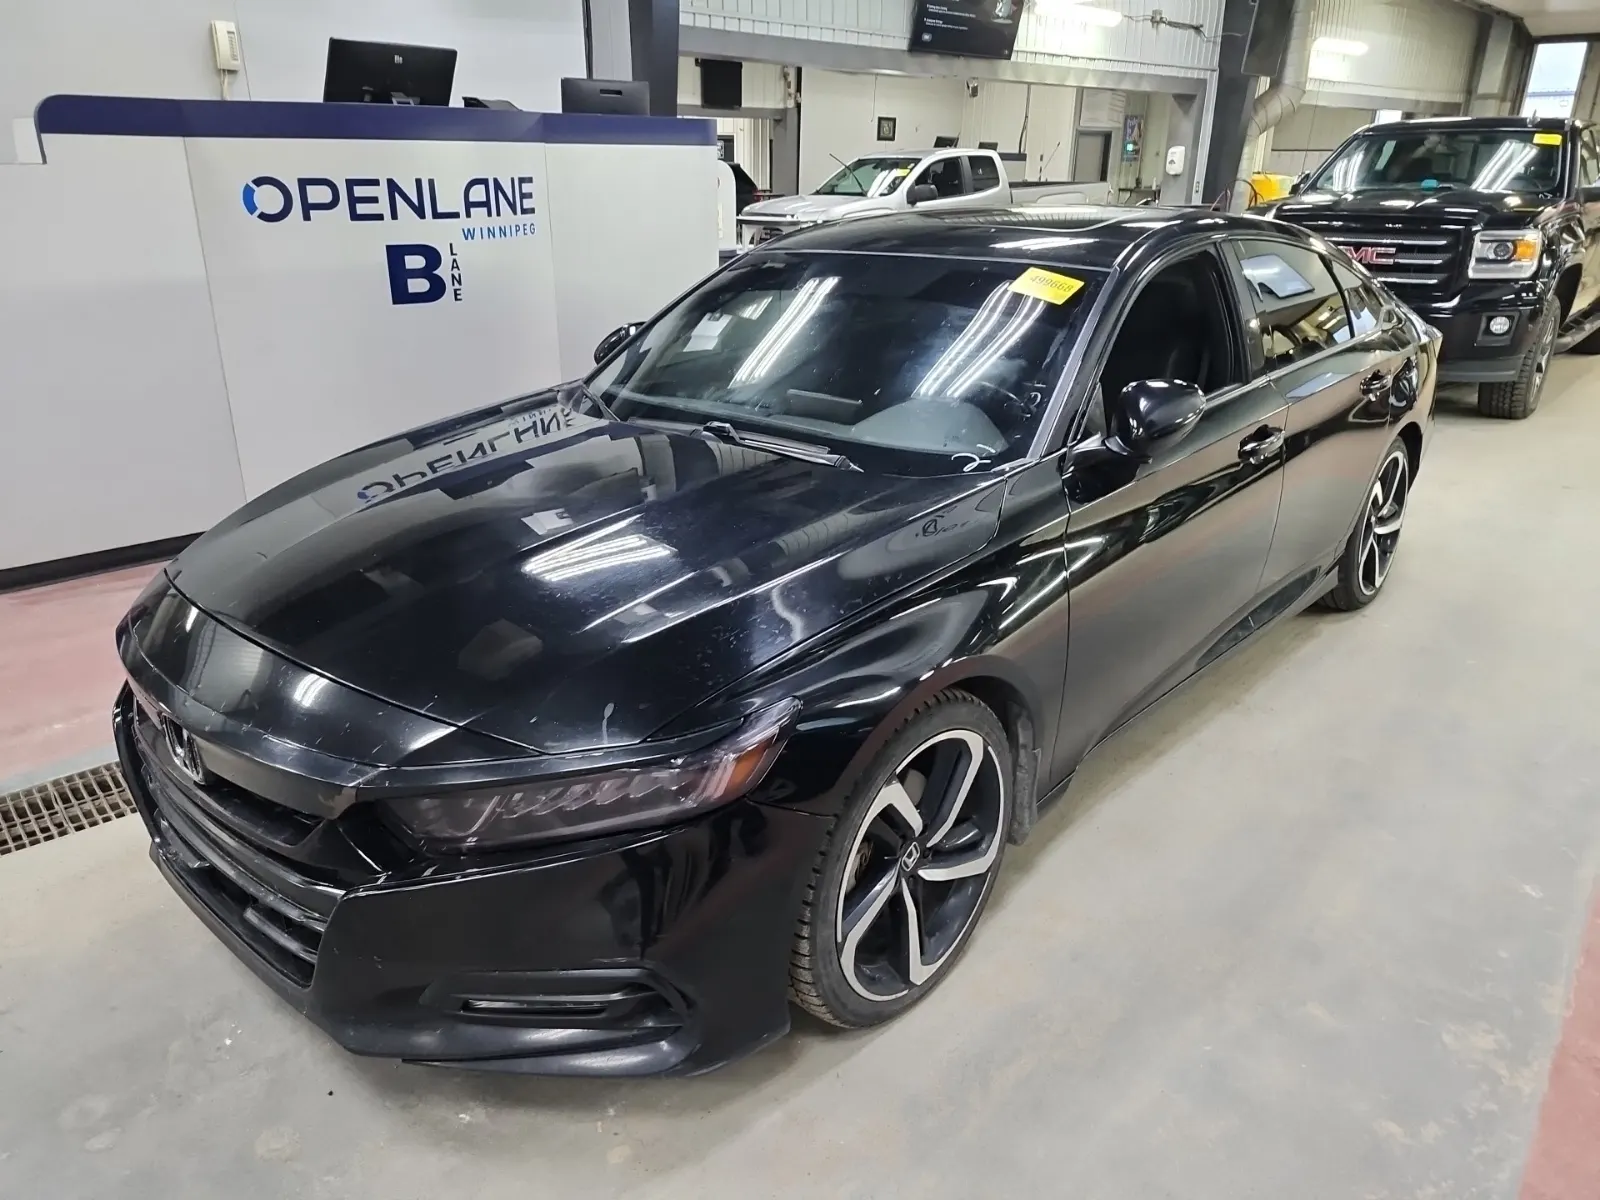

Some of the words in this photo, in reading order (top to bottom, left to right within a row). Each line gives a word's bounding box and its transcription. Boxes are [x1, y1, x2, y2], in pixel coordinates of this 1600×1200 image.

[242, 176, 536, 223] OPENLANE
[462, 223, 536, 241] WINNIPEG
[1337, 245, 1397, 265] MC
[385, 244, 447, 305] B
[449, 243, 463, 302] LANE
[1030, 275, 1074, 293] 499668
